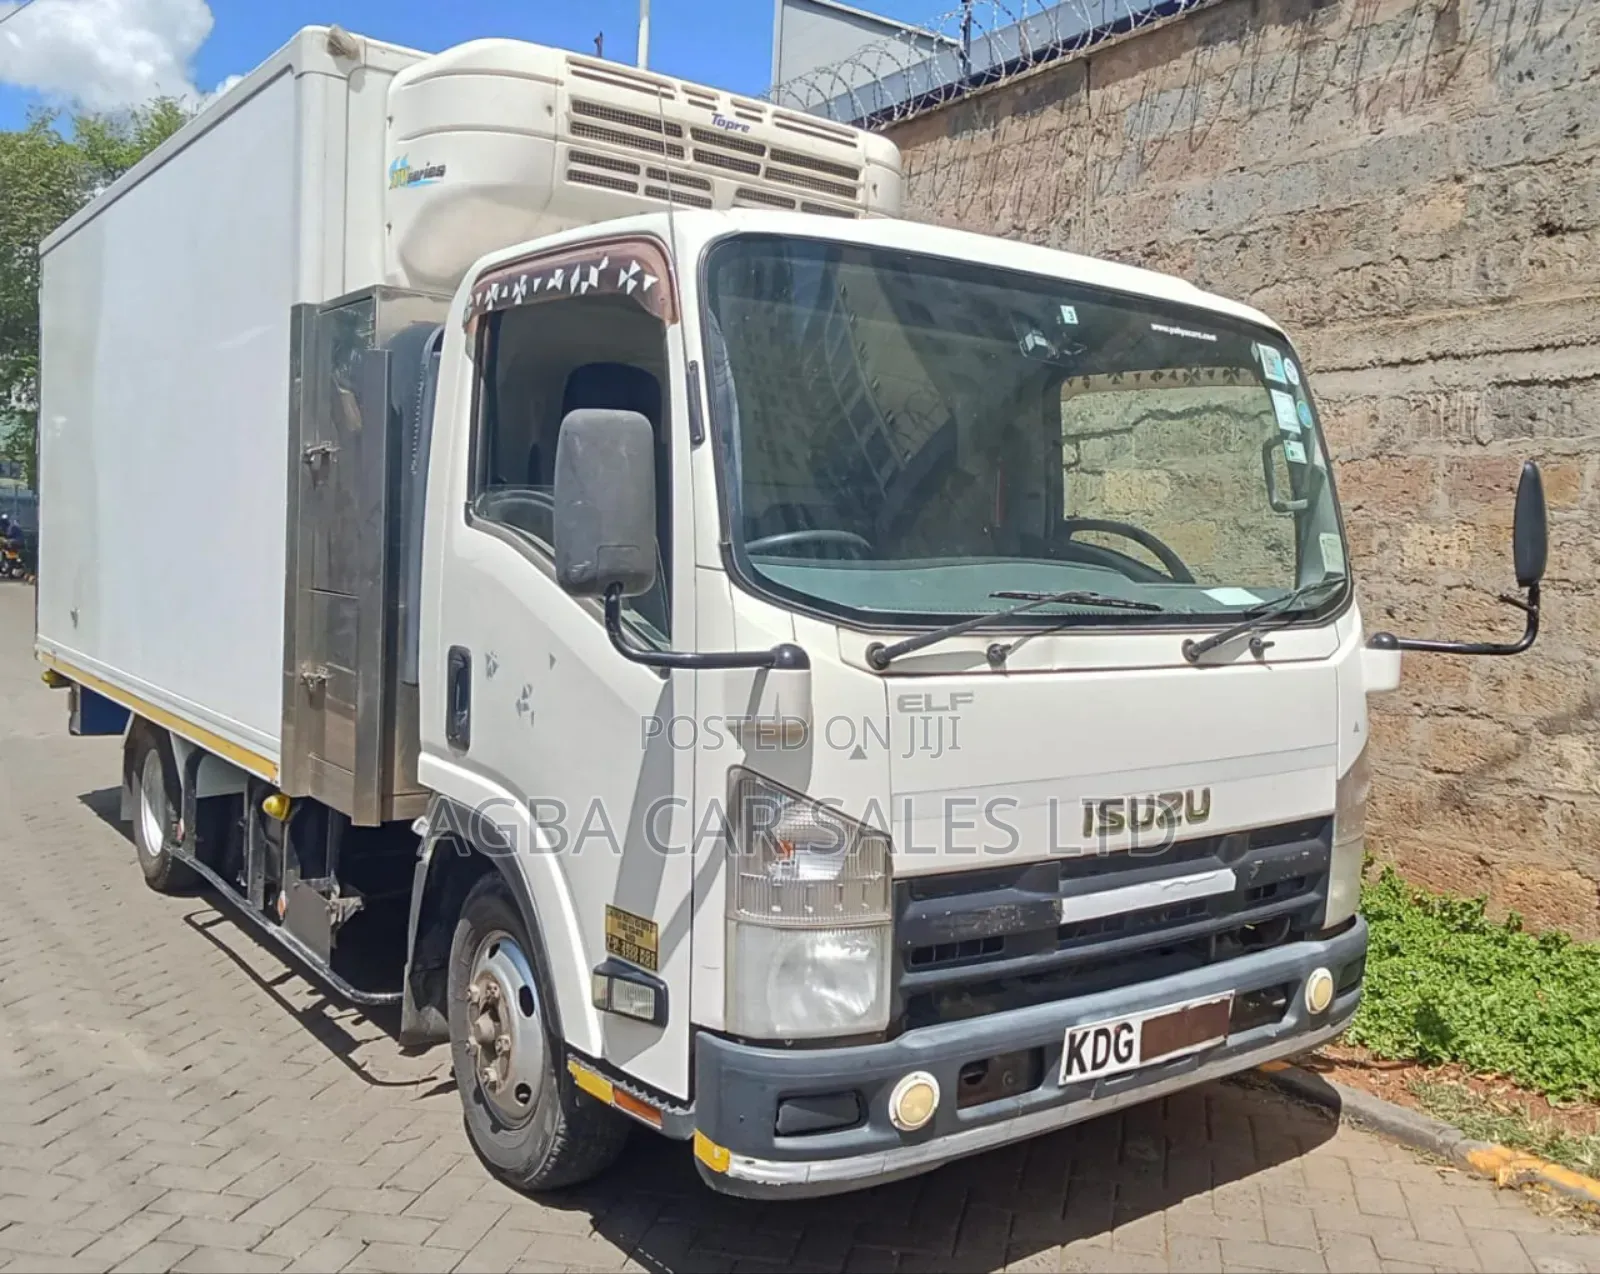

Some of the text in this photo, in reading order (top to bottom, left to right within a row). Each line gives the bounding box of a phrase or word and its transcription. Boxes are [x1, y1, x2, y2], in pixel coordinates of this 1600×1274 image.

[711, 112, 751, 133] Topre
[897, 692, 974, 713] ELF
[1082, 787, 1212, 839] ISUZU
[1064, 1021, 1135, 1076] KDG
